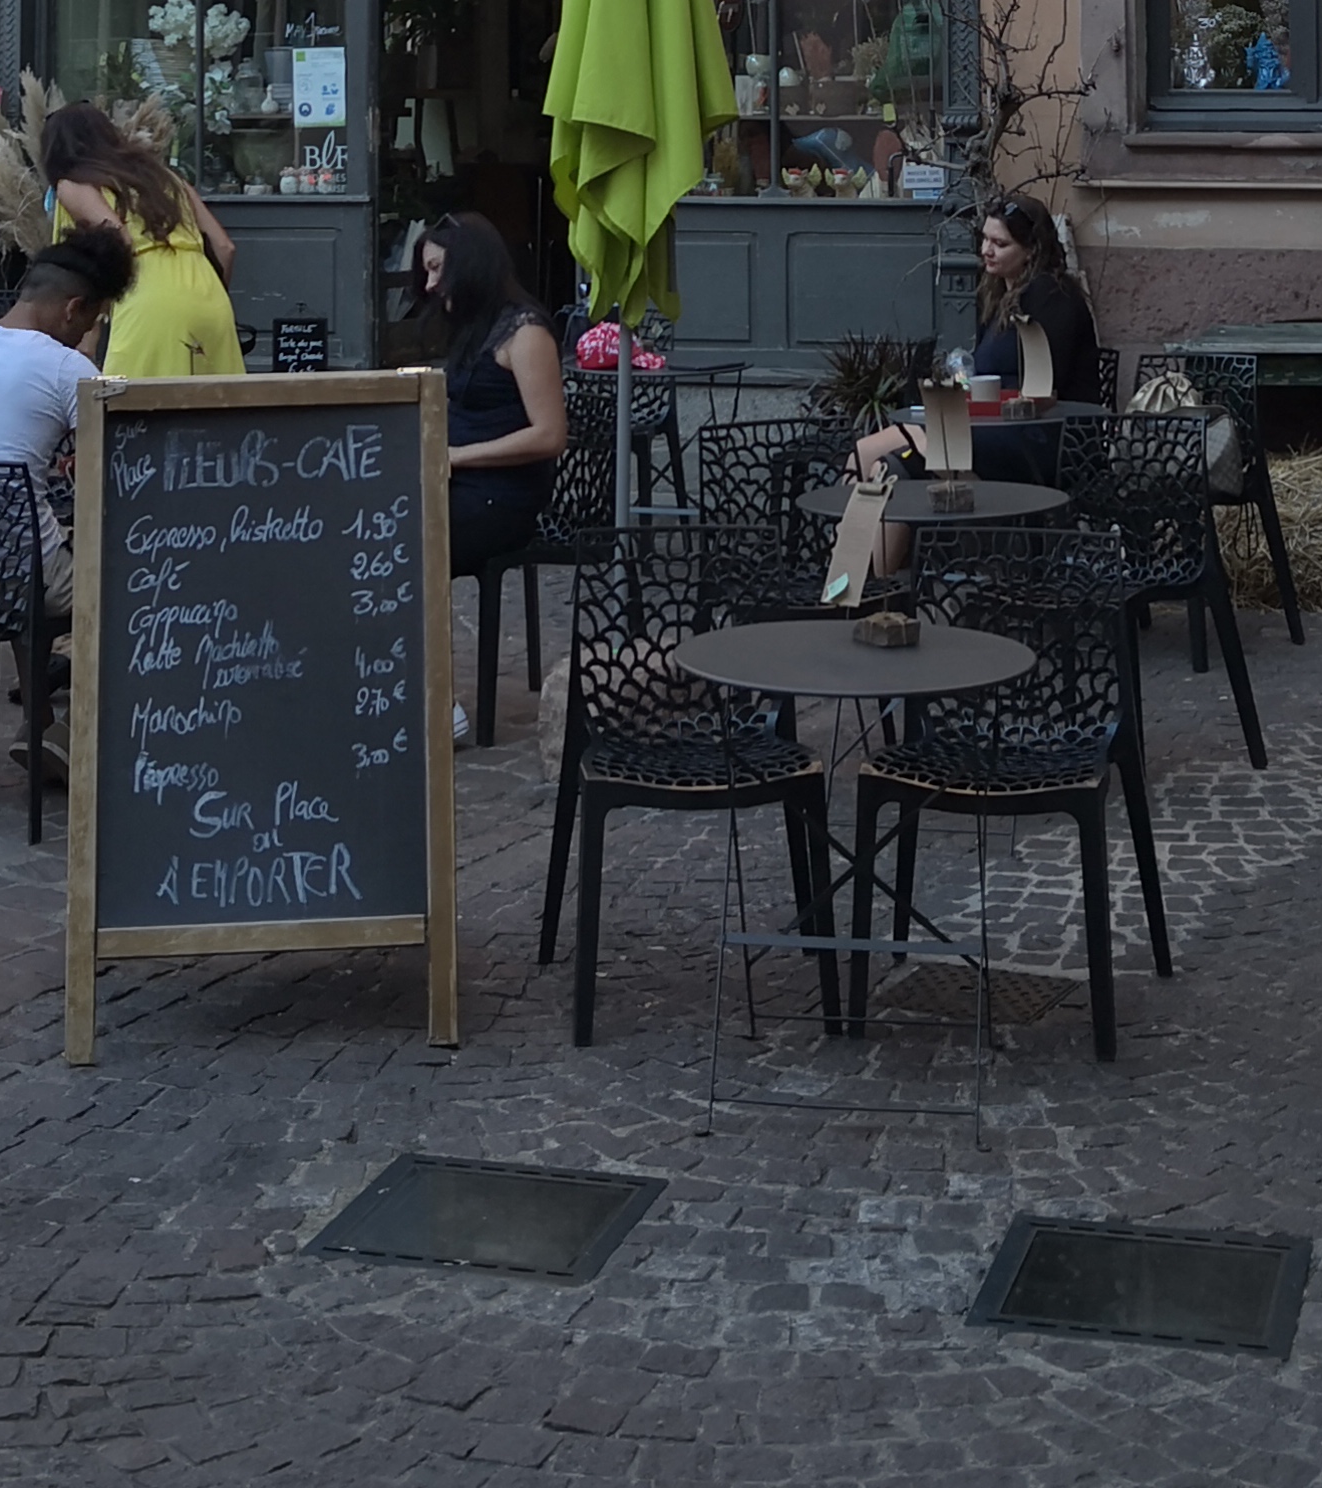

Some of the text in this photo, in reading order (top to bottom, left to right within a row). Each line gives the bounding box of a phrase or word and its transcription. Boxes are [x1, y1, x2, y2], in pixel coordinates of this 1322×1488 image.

[109, 449, 157, 500] Place
[163, 423, 383, 493] FLEURS-CAFÉ
[127, 556, 190, 608] Café
[275, 779, 341, 824] Place
[190, 841, 364, 908] EMPORTER
